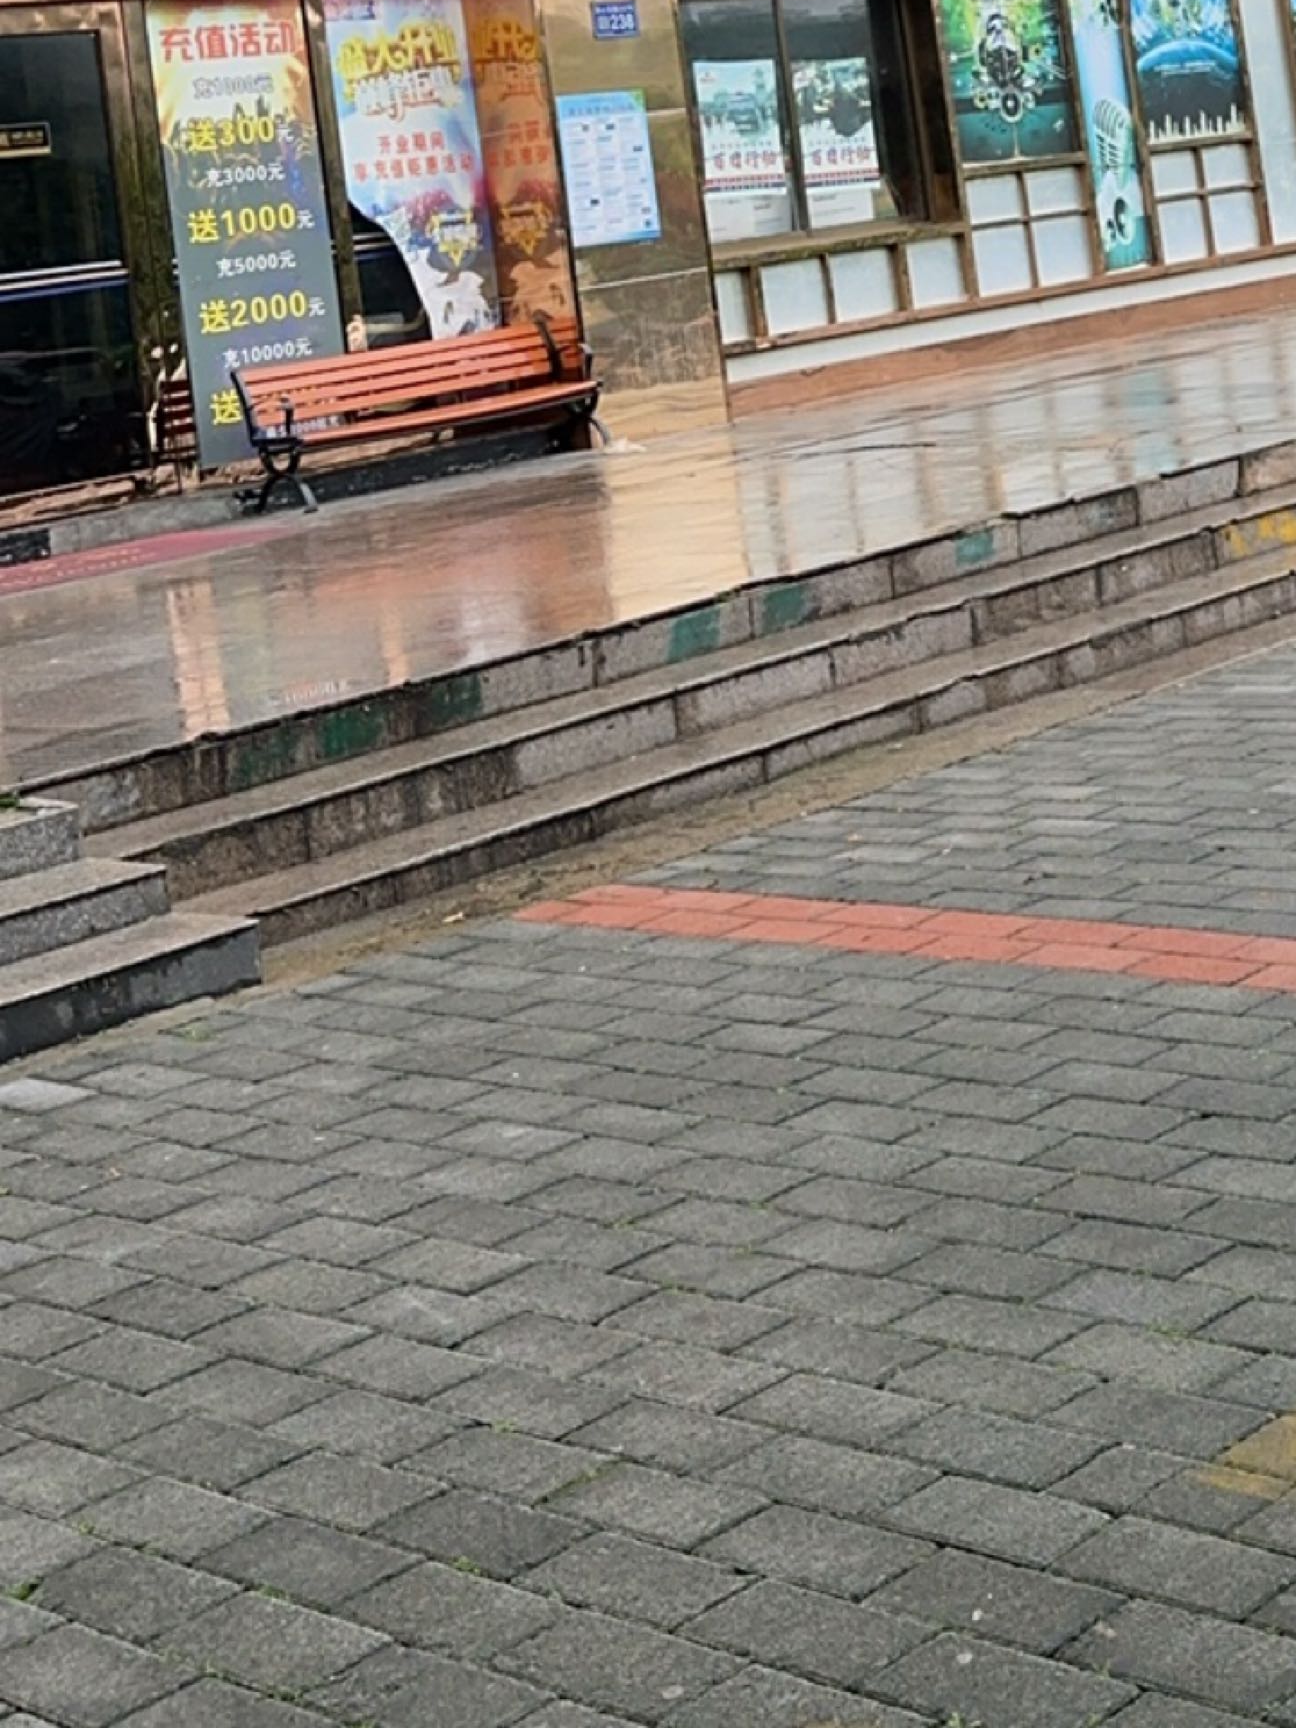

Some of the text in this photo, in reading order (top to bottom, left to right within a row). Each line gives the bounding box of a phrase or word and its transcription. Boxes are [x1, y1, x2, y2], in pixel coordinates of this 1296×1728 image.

[159, 22, 295, 62] 充值活动
[187, 116, 295, 151] 送300元
[205, 162, 286, 188] 充3000元
[187, 202, 314, 244] 送1000元
[216, 250, 297, 278] 充5000元
[199, 290, 325, 334] 送2000元
[222, 338, 313, 368] 充10000元
